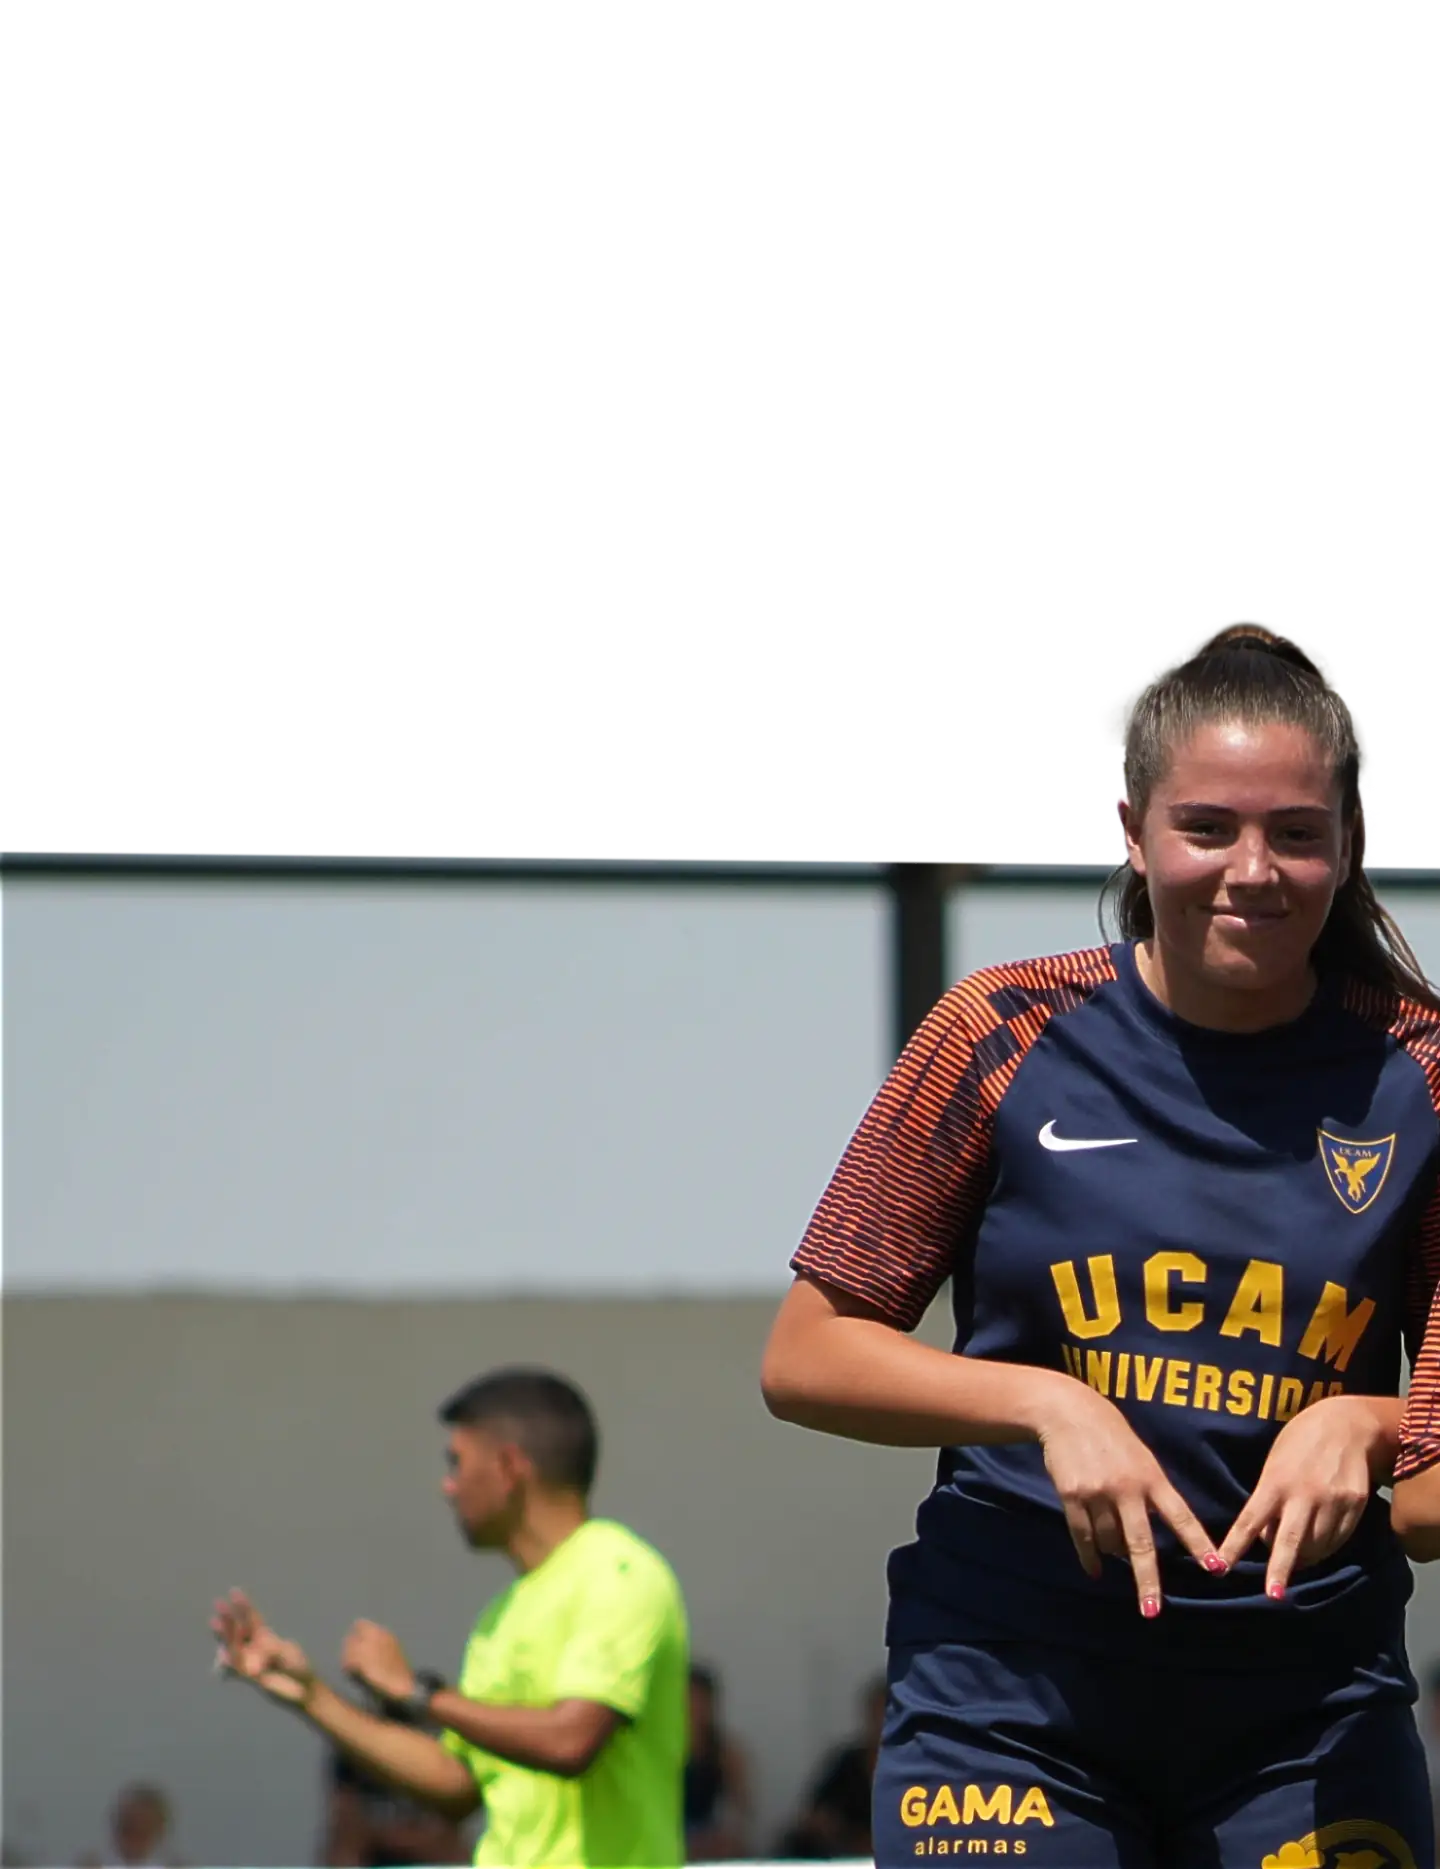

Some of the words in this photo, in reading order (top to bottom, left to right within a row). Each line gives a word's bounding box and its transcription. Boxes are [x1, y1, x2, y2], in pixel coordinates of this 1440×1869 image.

[1050, 1250, 1376, 1373] UCAM
[901, 1784, 1055, 1828] GAMA
[914, 1836, 1027, 1856] alarmas
